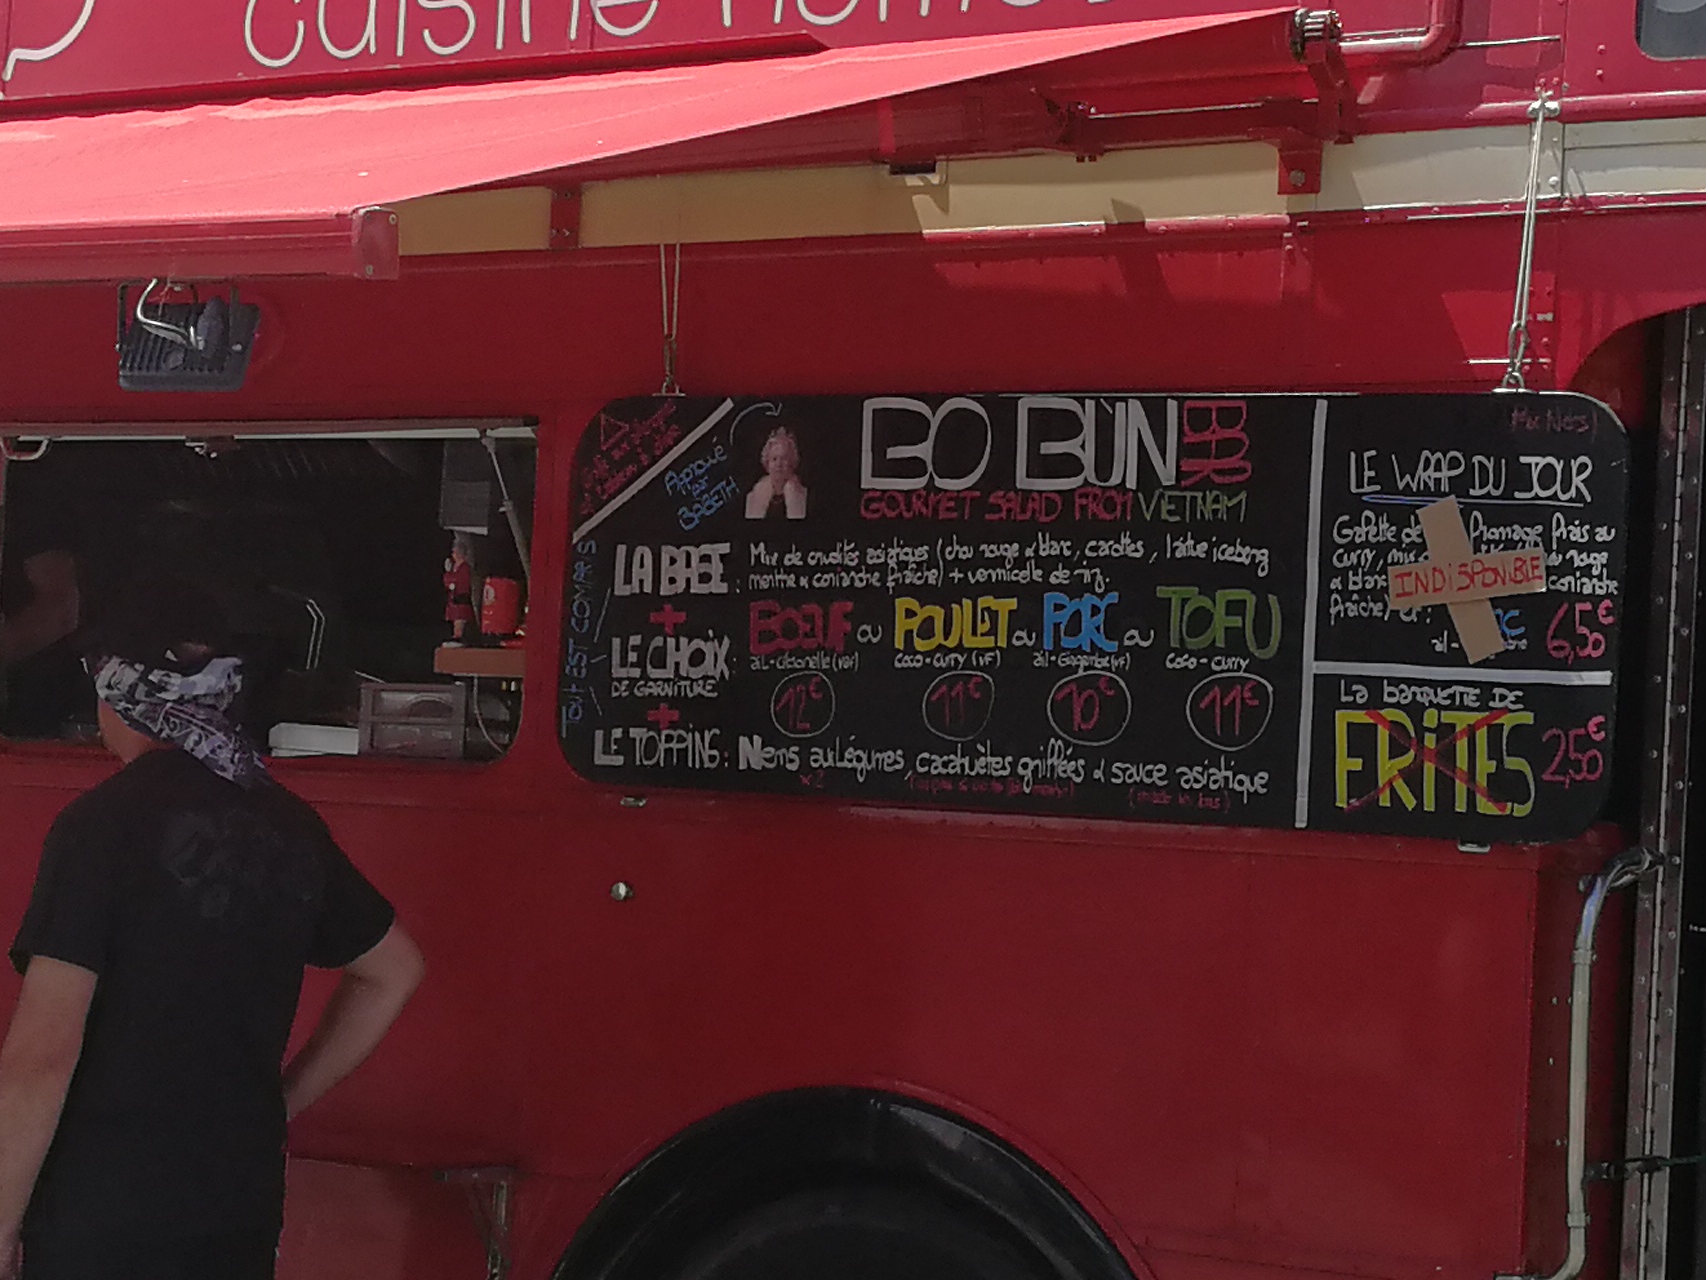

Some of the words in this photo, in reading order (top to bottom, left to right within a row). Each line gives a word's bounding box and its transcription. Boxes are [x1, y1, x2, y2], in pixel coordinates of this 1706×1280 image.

[860, 397, 992, 490] BO
[1349, 450, 1382, 494] LE
[1391, 449, 1465, 493] WRAP
[1468, 454, 1506, 497] DU
[1513, 455, 1593, 503] JOUR
[859, 489, 981, 520] GOURMET
[984, 489, 1064, 523] SALAD
[1074, 487, 1133, 520] FROM
[1138, 489, 1247, 523] VIETNAM
[613, 543, 653, 597] LA
[894, 596, 1018, 652] POULET
[1155, 585, 1283, 660] TOFU
[611, 634, 643, 680] LE
[593, 726, 626, 766] LE
